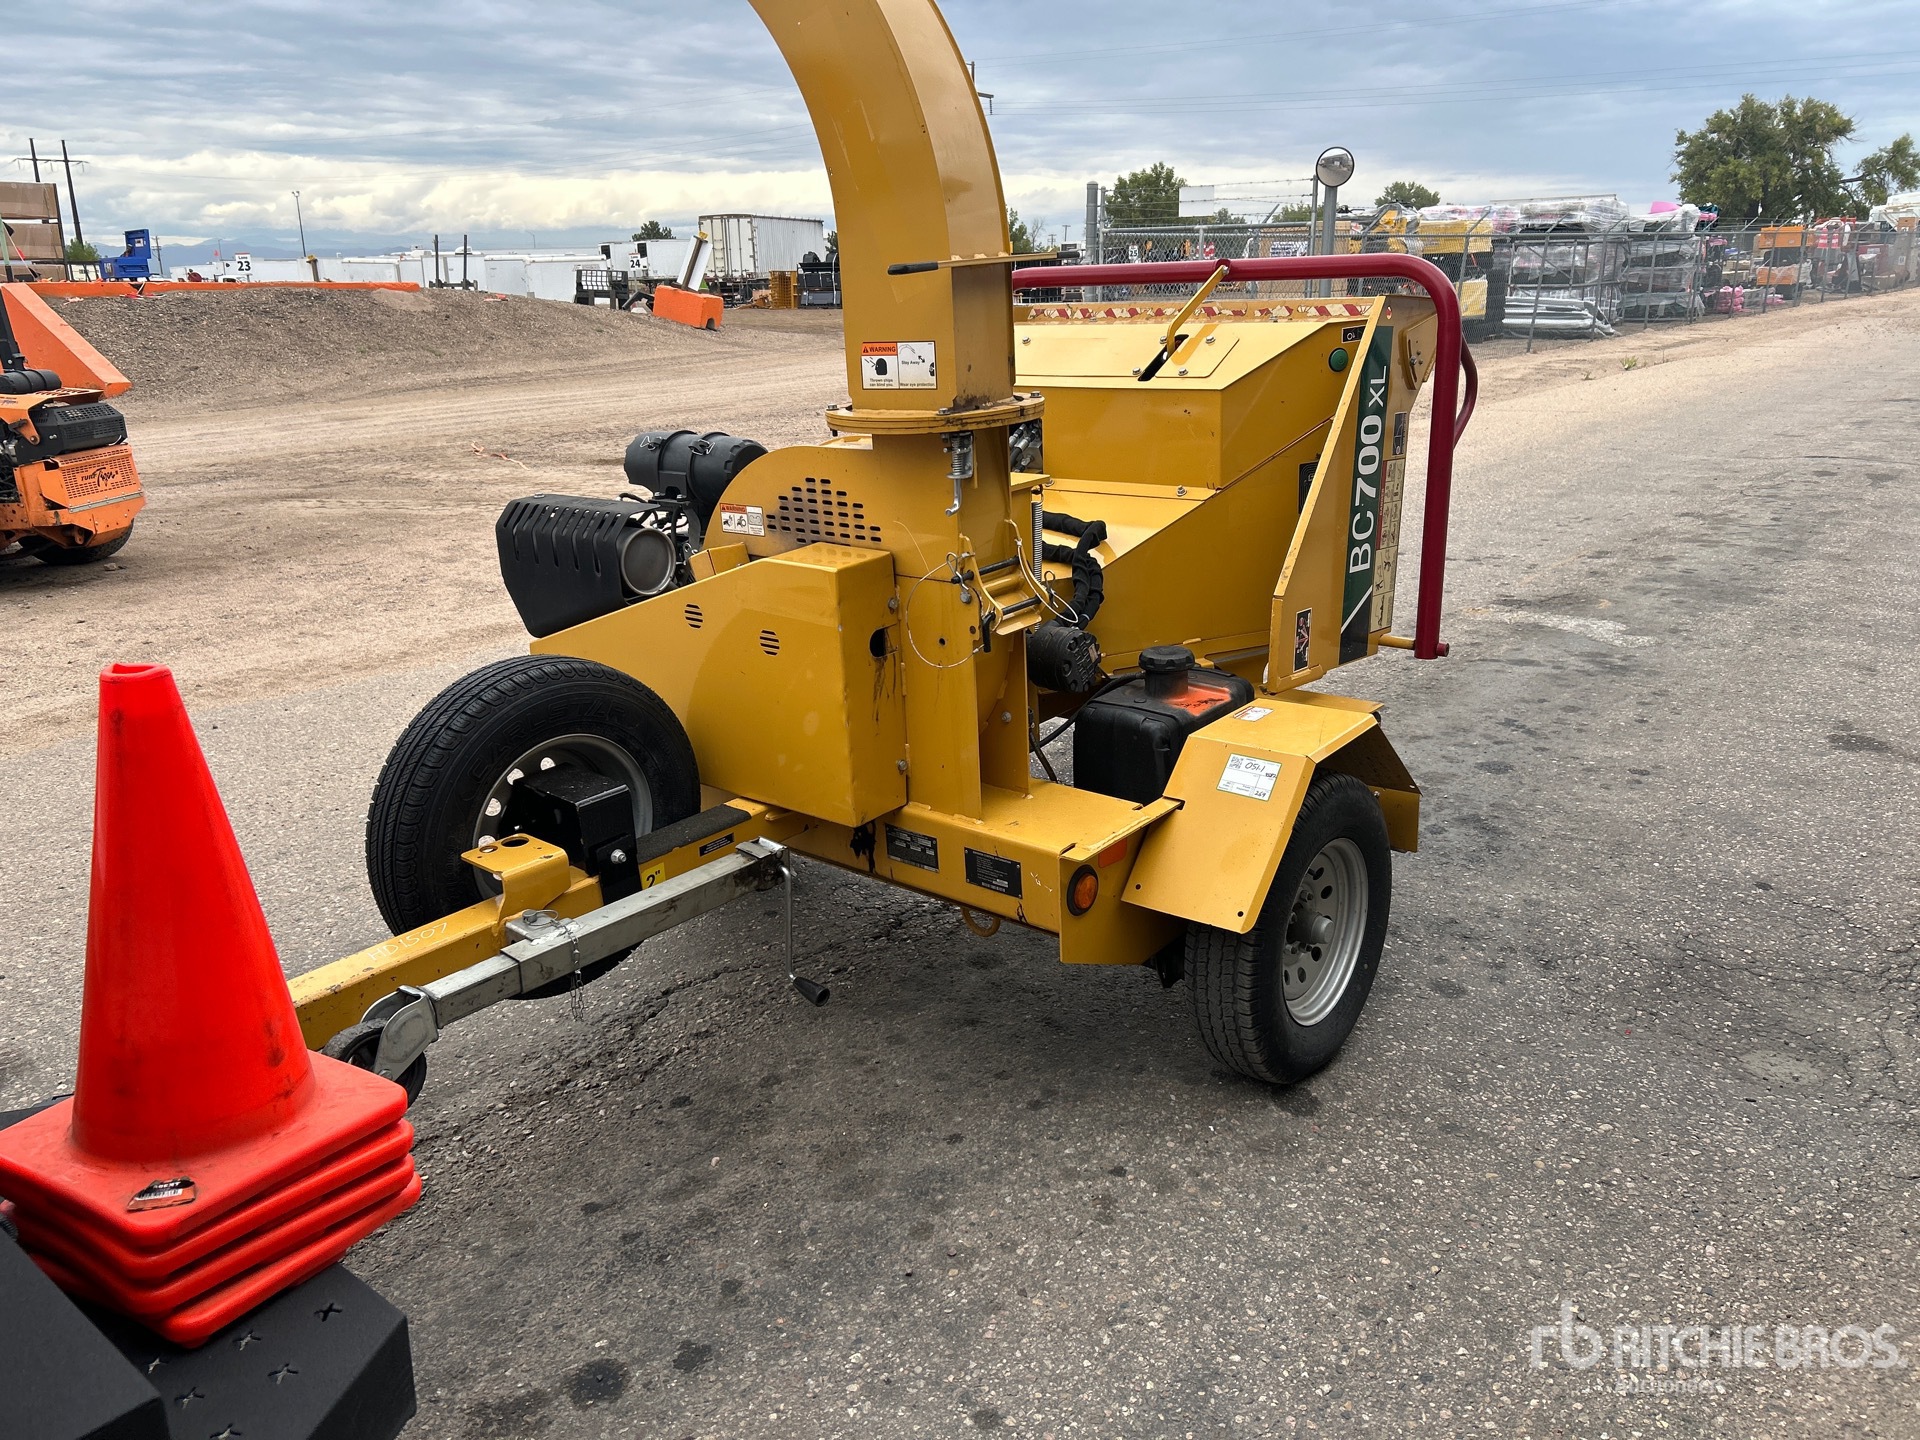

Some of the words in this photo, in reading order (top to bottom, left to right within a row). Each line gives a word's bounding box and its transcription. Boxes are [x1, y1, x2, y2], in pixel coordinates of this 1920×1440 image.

[237, 261, 251, 271] 23
[630, 259, 640, 268] 24
[1368, 365, 1387, 408] XL
[725, 504, 746, 512] WARNING
